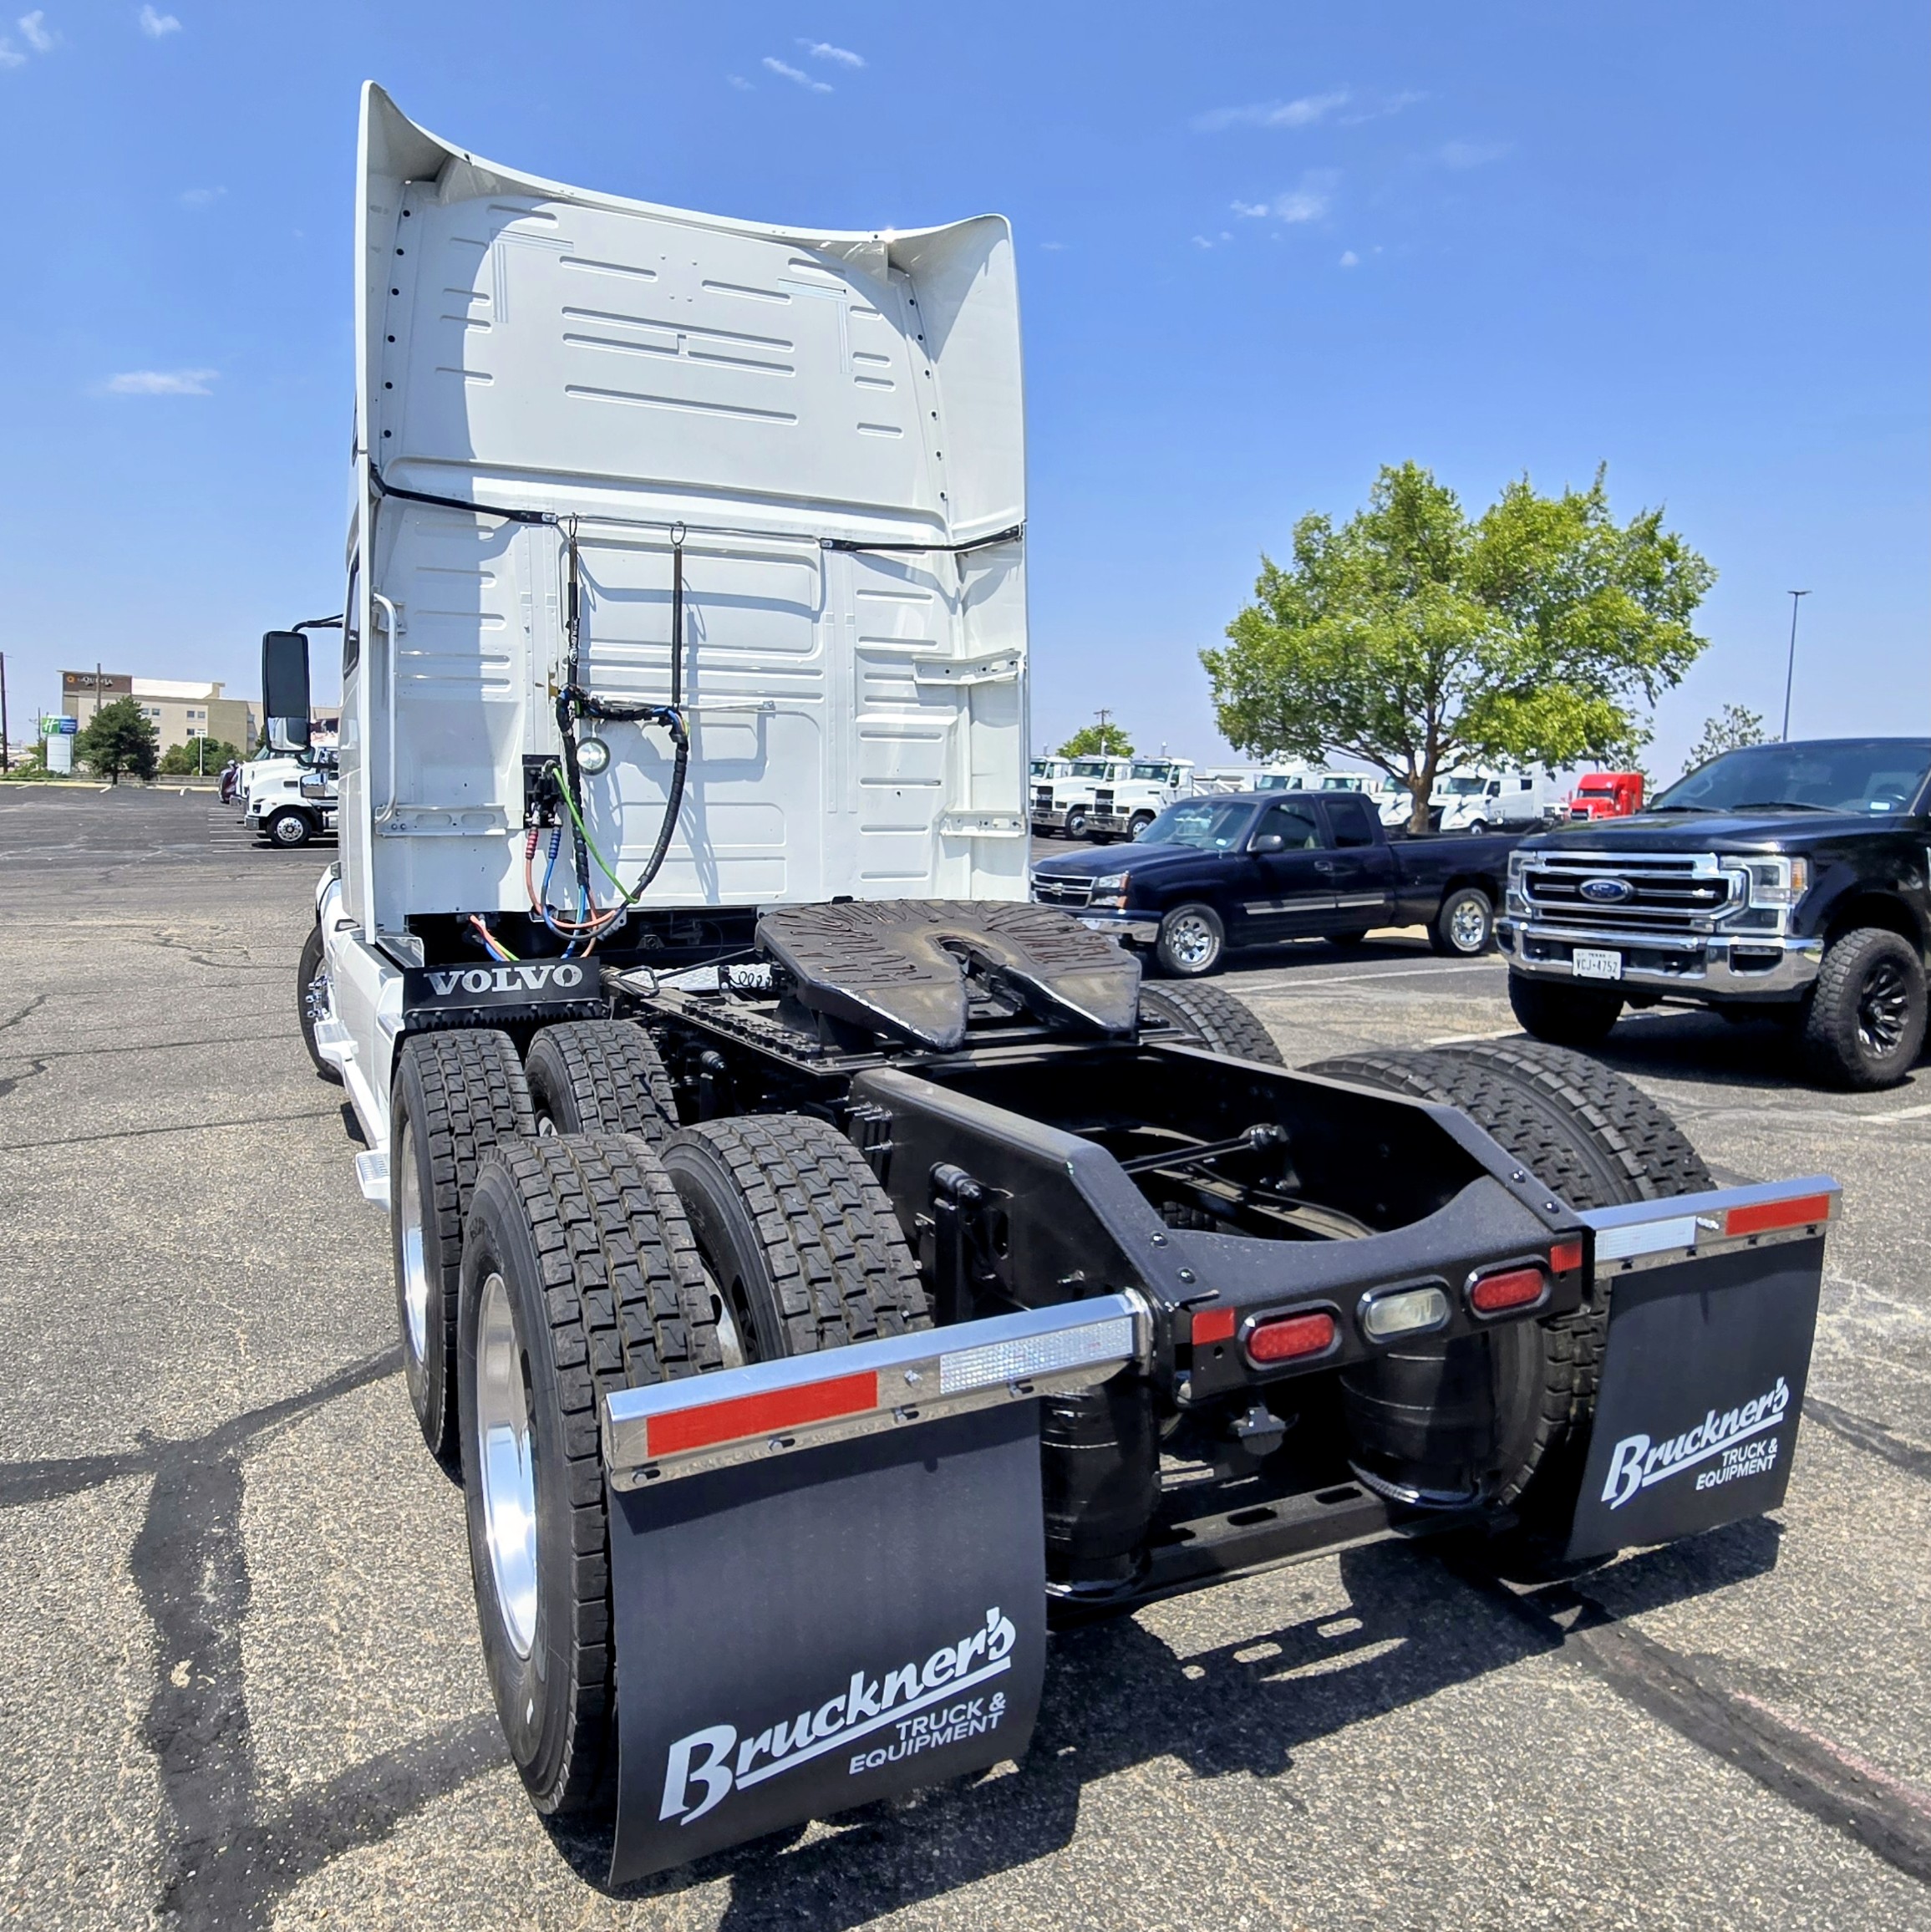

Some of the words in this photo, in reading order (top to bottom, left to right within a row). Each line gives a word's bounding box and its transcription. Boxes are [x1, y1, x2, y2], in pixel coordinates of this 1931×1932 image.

[423, 963, 583, 996] VOLVO
[1601, 1376, 1790, 1510] Bruckner's
[1721, 1440, 1767, 1467] TRUCK
[1767, 1437, 1778, 1453] &
[1695, 1454, 1776, 1491] EQUIPMENT
[658, 1606, 1016, 1826] Bruckner's
[896, 1699, 982, 1741] TRUCK
[988, 1691, 1007, 1710] &
[848, 1710, 1004, 1775] EQUIPMENT
